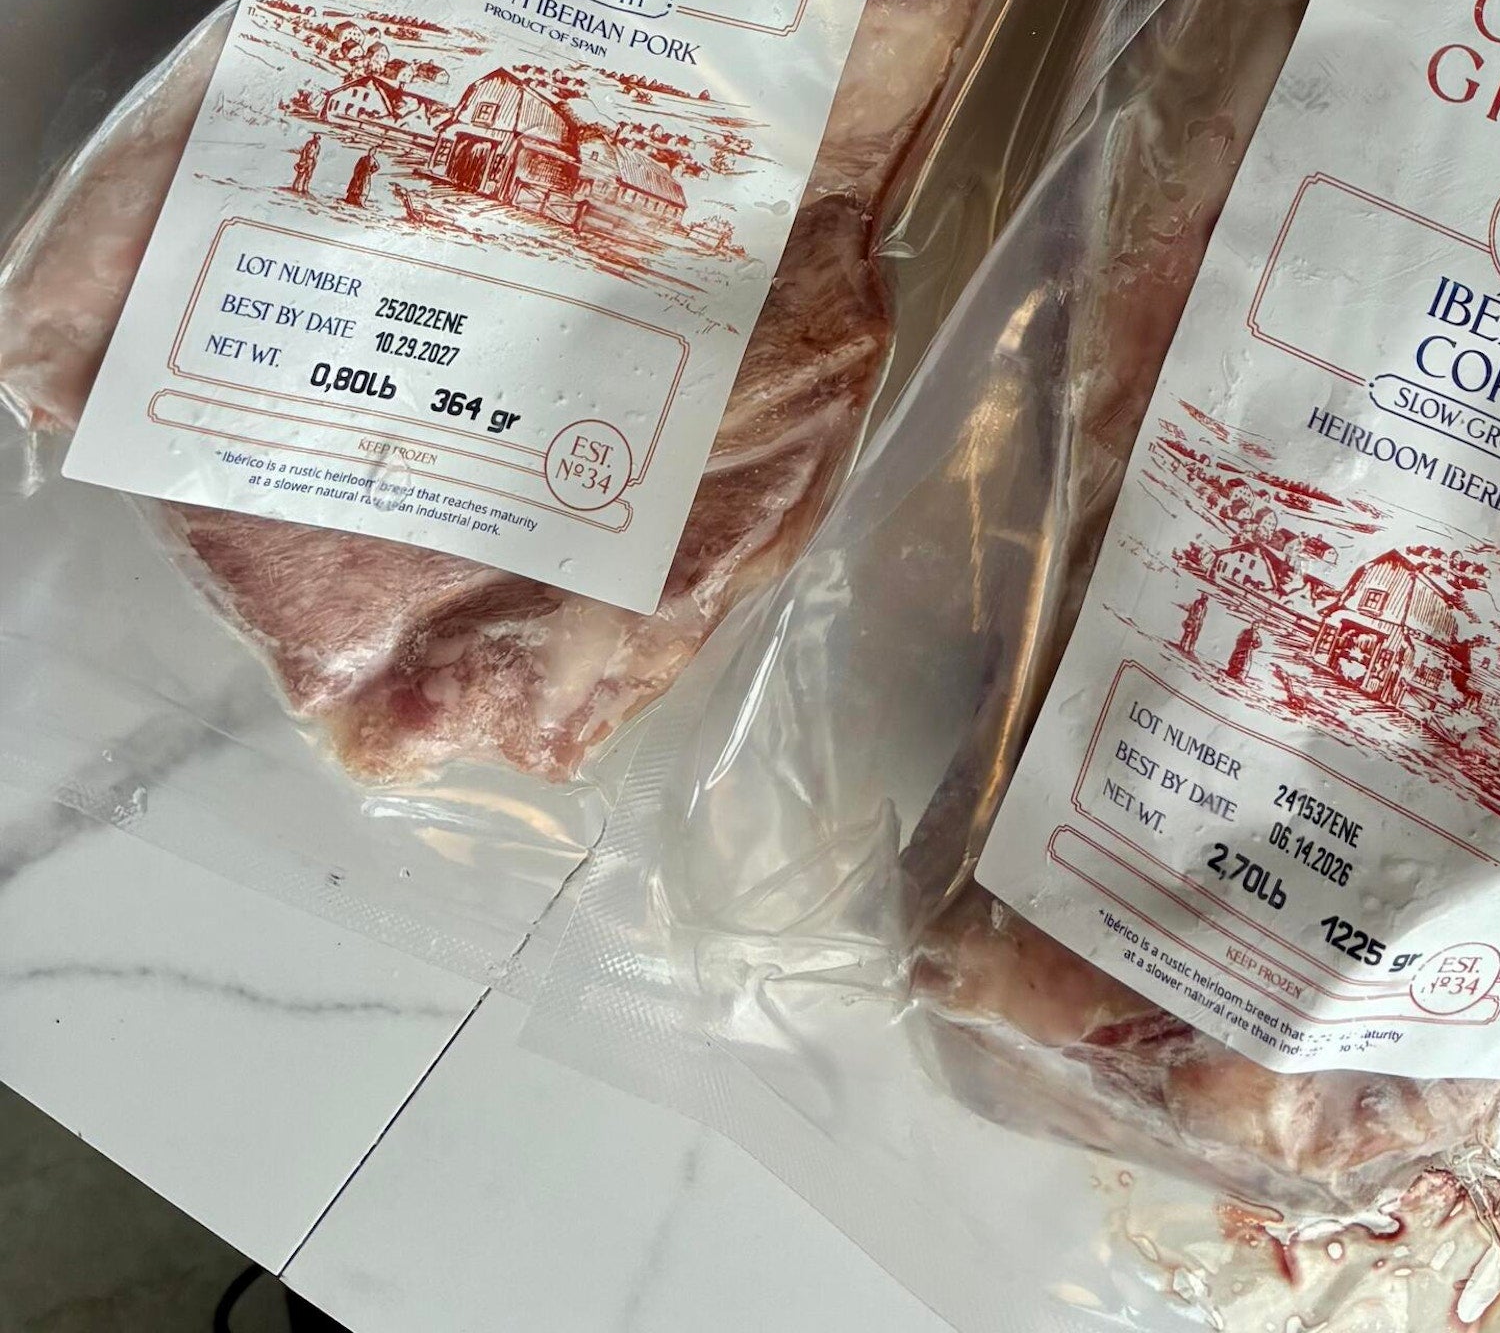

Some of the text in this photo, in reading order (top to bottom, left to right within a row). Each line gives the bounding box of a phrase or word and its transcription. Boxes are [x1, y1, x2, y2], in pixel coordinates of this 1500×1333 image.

[484, 2, 607, 57] PRODUCT OF SPAIN
[629, 29, 700, 65] PORK
[220, 293, 460, 367] BEST BY DATE 10.29.2027
[235, 253, 468, 335] LOT NUMBER 252022ENE
[204, 334, 247, 359] NET
[252, 343, 282, 368] WT.
[430, 388, 483, 421] 364
[486, 409, 521, 434] gr
[1307, 406, 1439, 480] HEIRLOOM
[1128, 700, 1363, 848] LOT NUMBER 241537ENE
[1114, 739, 1353, 887] BEST BY DATE 06.14.2026
[1320, 915, 1386, 966] 1225
[1388, 953, 1423, 973] gr
